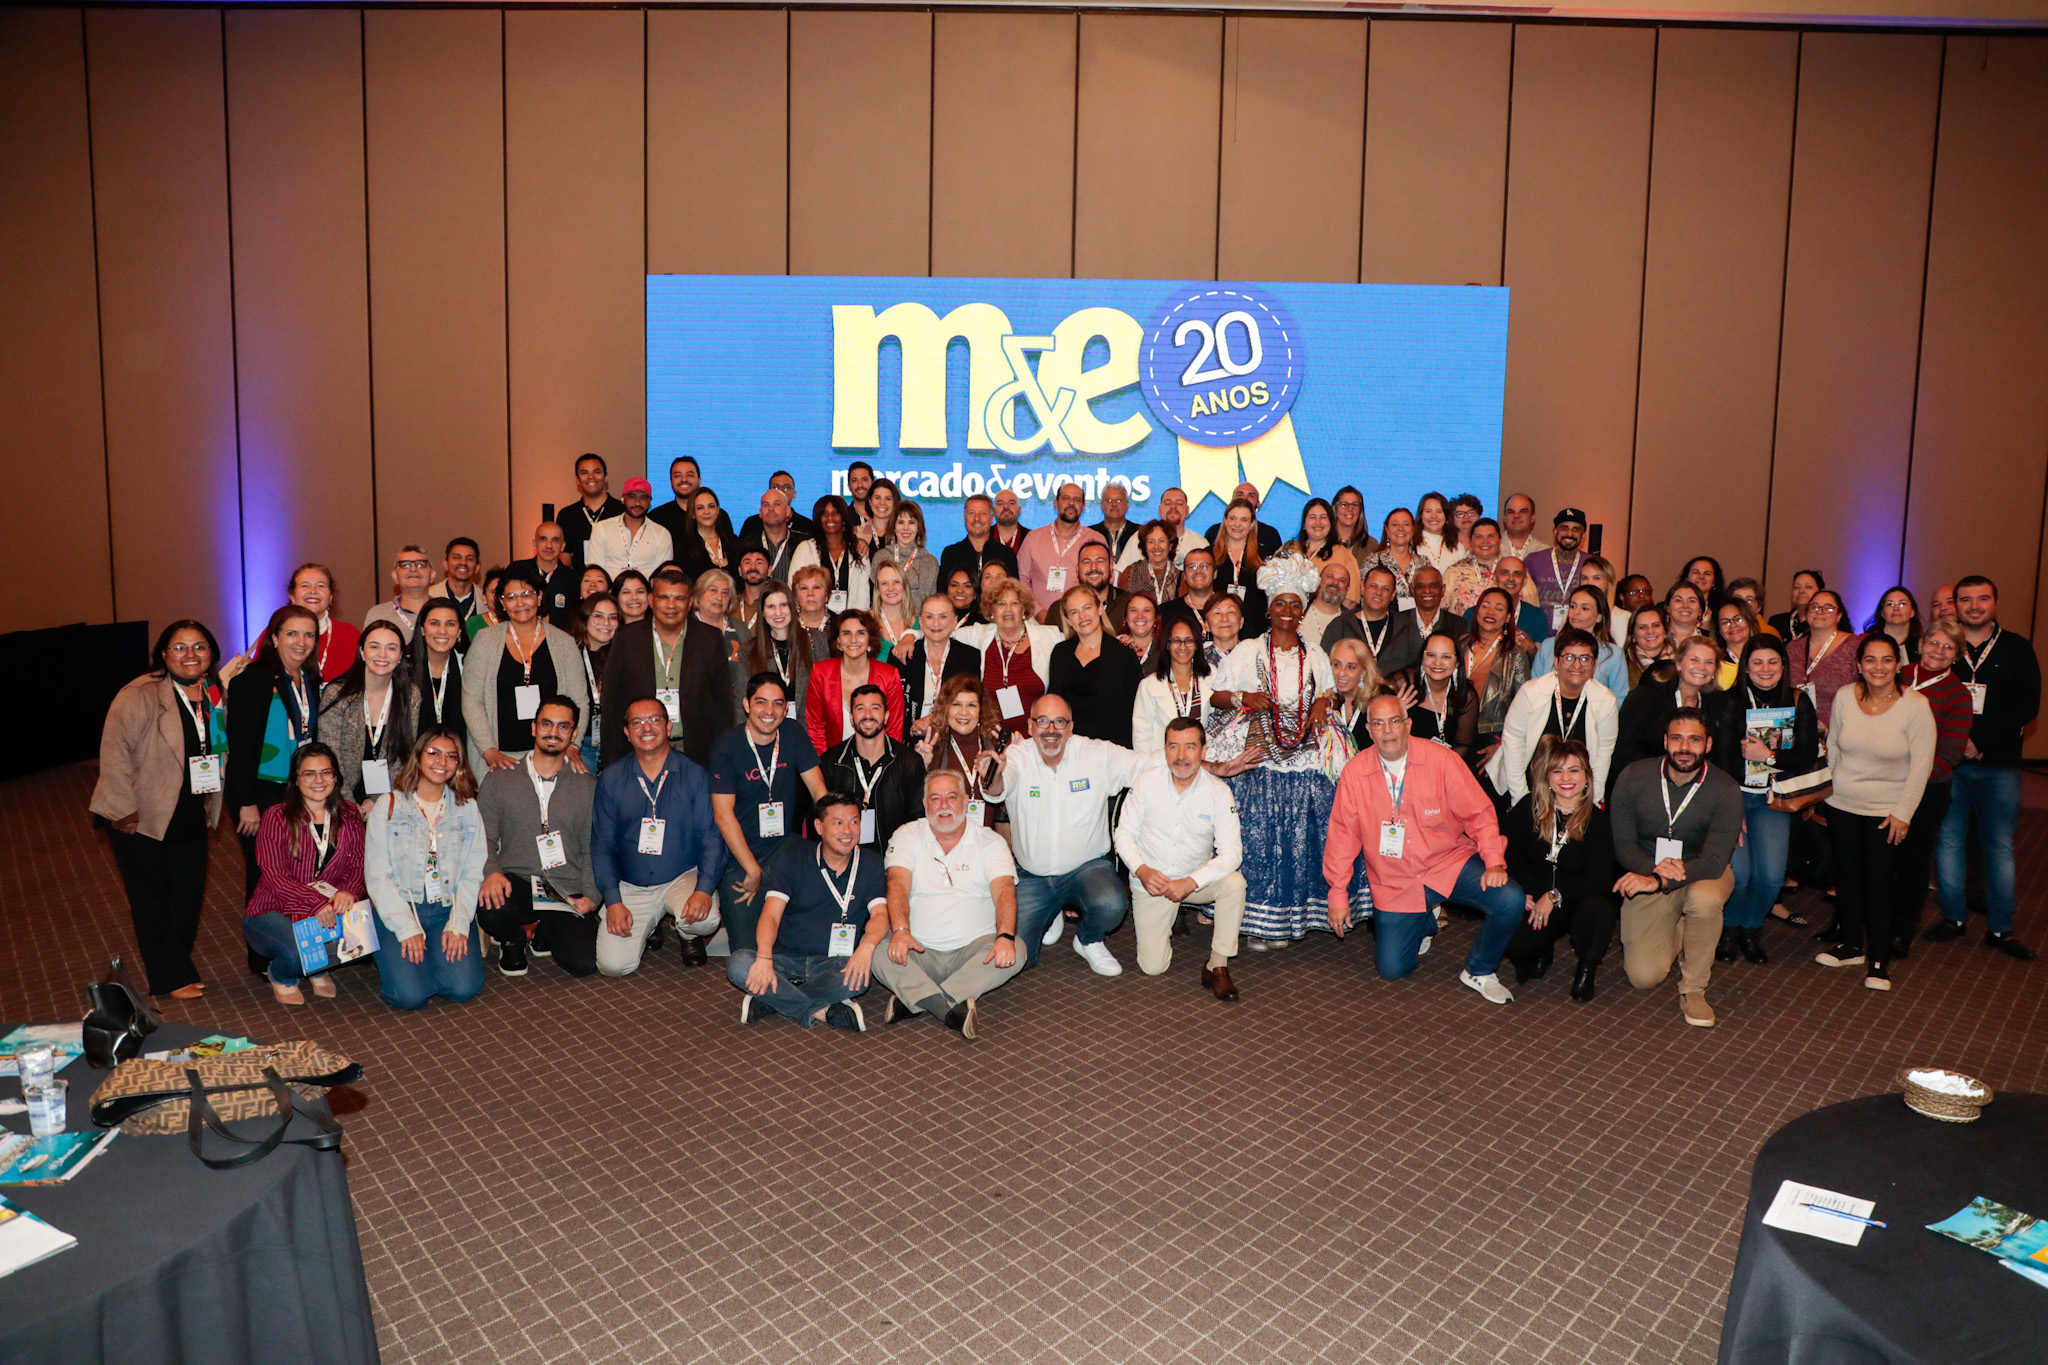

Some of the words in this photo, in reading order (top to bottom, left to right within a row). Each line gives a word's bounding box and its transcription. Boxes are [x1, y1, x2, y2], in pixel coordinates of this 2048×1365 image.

[831, 302, 1153, 455] m&e
[1174, 311, 1263, 386] 20
[1190, 382, 1270, 418] ANOS
